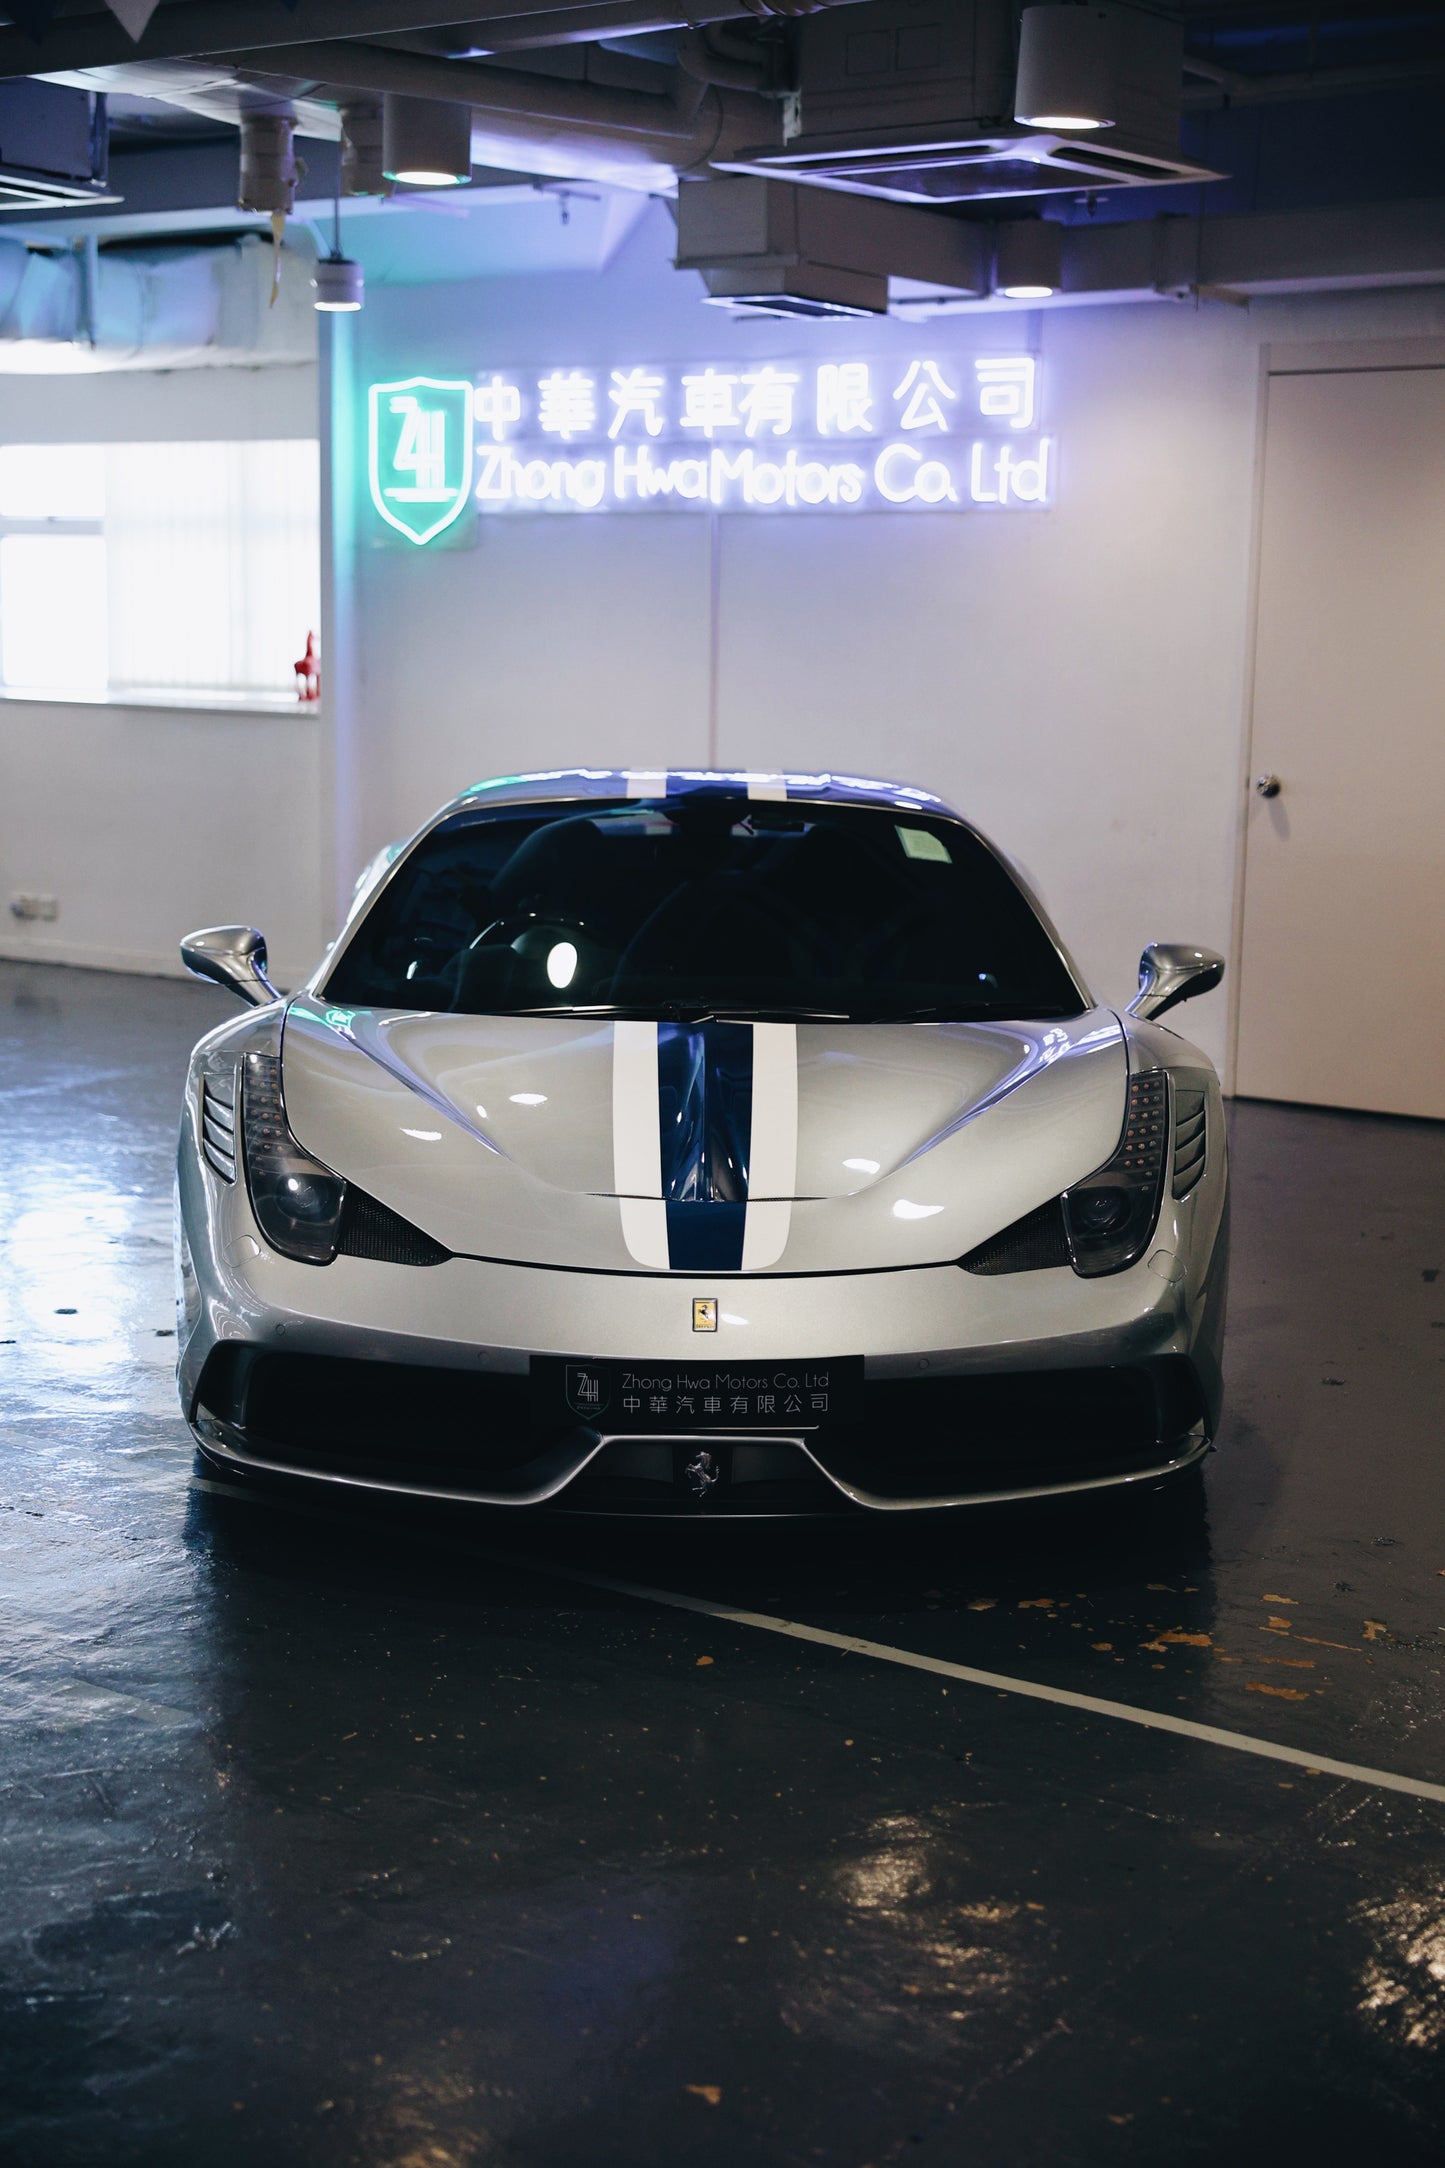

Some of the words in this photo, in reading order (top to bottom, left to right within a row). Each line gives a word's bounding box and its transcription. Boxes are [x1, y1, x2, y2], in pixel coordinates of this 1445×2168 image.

[473, 356, 1036, 441] 中華汽車有限公司
[475, 445, 605, 507] Zhong
[614, 444, 708, 499] Hwa
[710, 448, 865, 504] Motors
[970, 437, 1049, 504] Ltd
[622, 1373, 672, 1391] Zhong
[676, 1373, 710, 1389] Hwa
[715, 1374, 768, 1389] Motors
[773, 1372, 800, 1389] Co.
[805, 1371, 829, 1388] Ltd
[623, 1393, 829, 1414] 中華汽車有限公司
